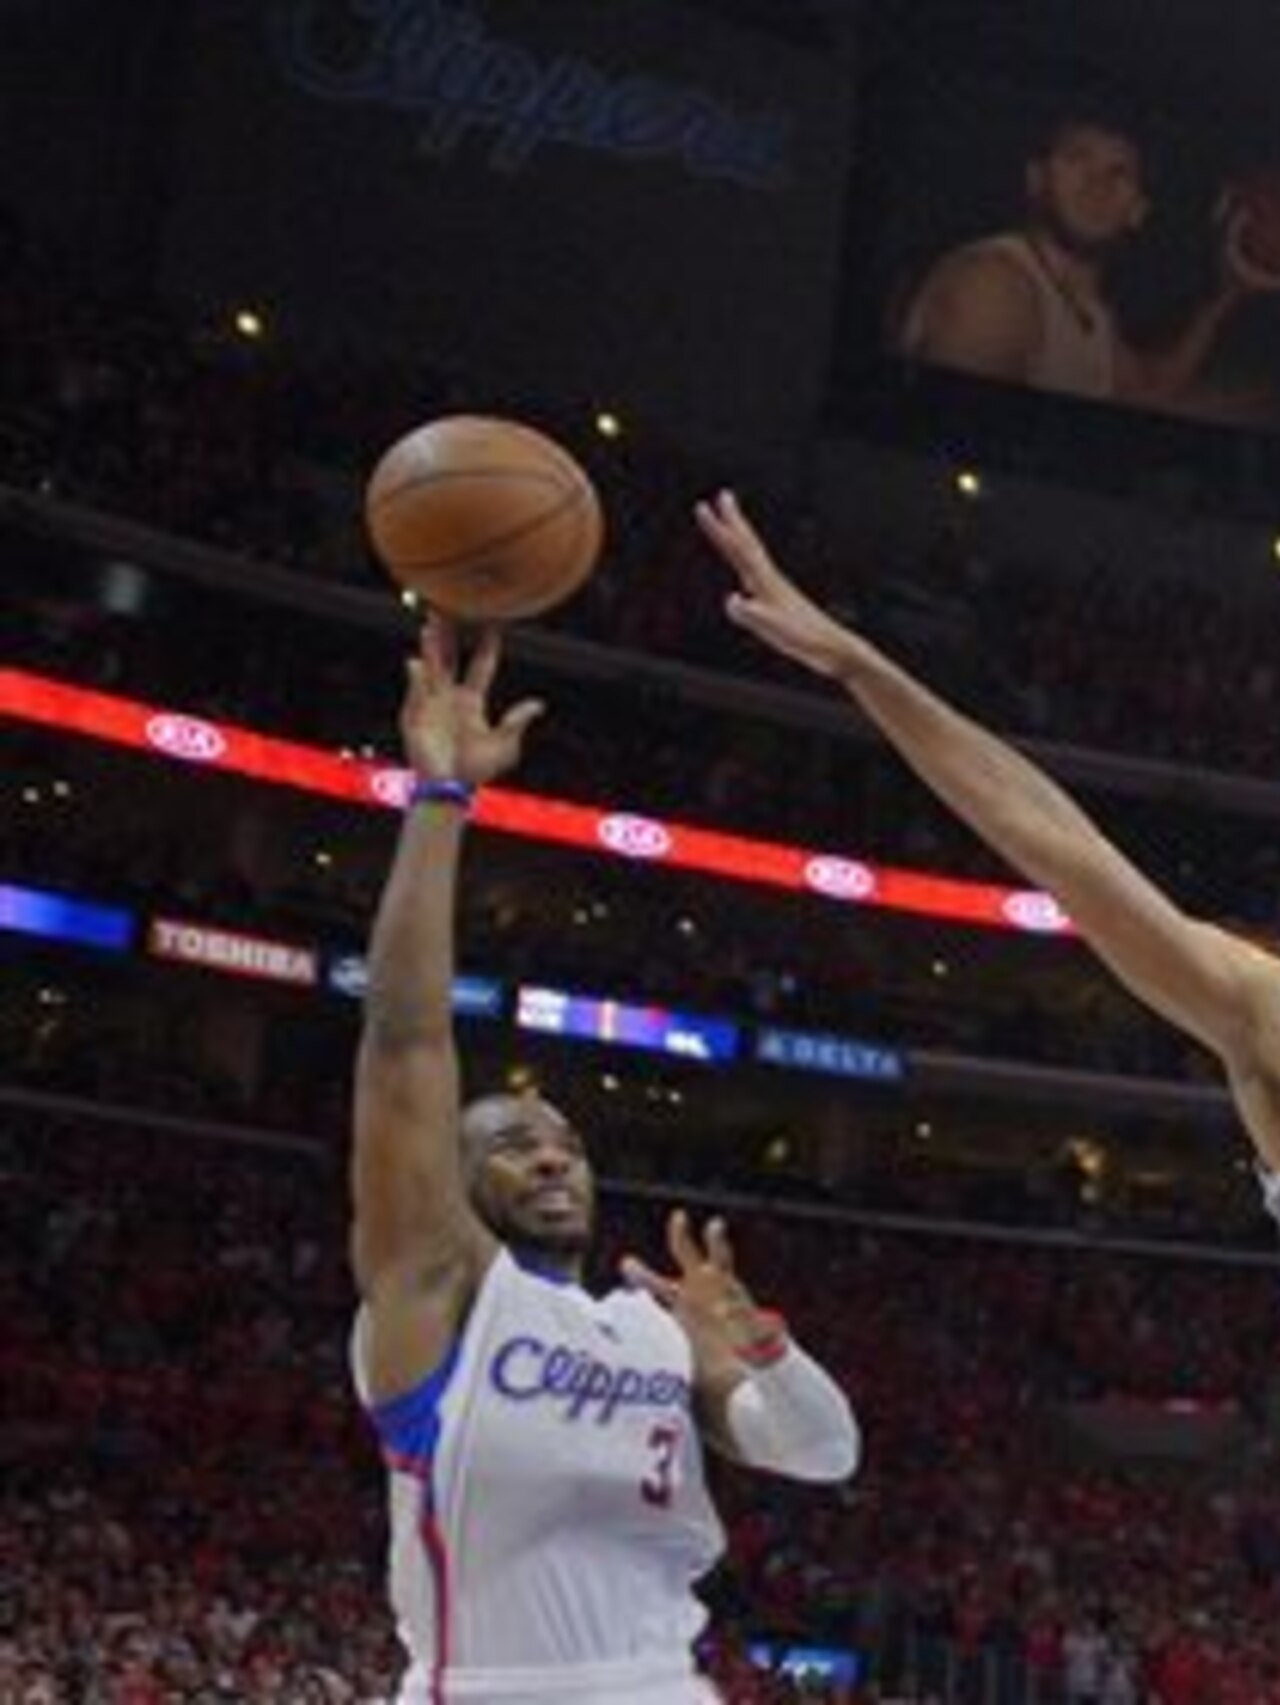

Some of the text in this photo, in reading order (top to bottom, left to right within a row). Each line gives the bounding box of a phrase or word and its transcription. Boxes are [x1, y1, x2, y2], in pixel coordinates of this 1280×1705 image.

[152, 919, 316, 984] TOSHIBA
[793, 1036, 900, 1076] DELTA
[641, 1424, 680, 1506] 3
